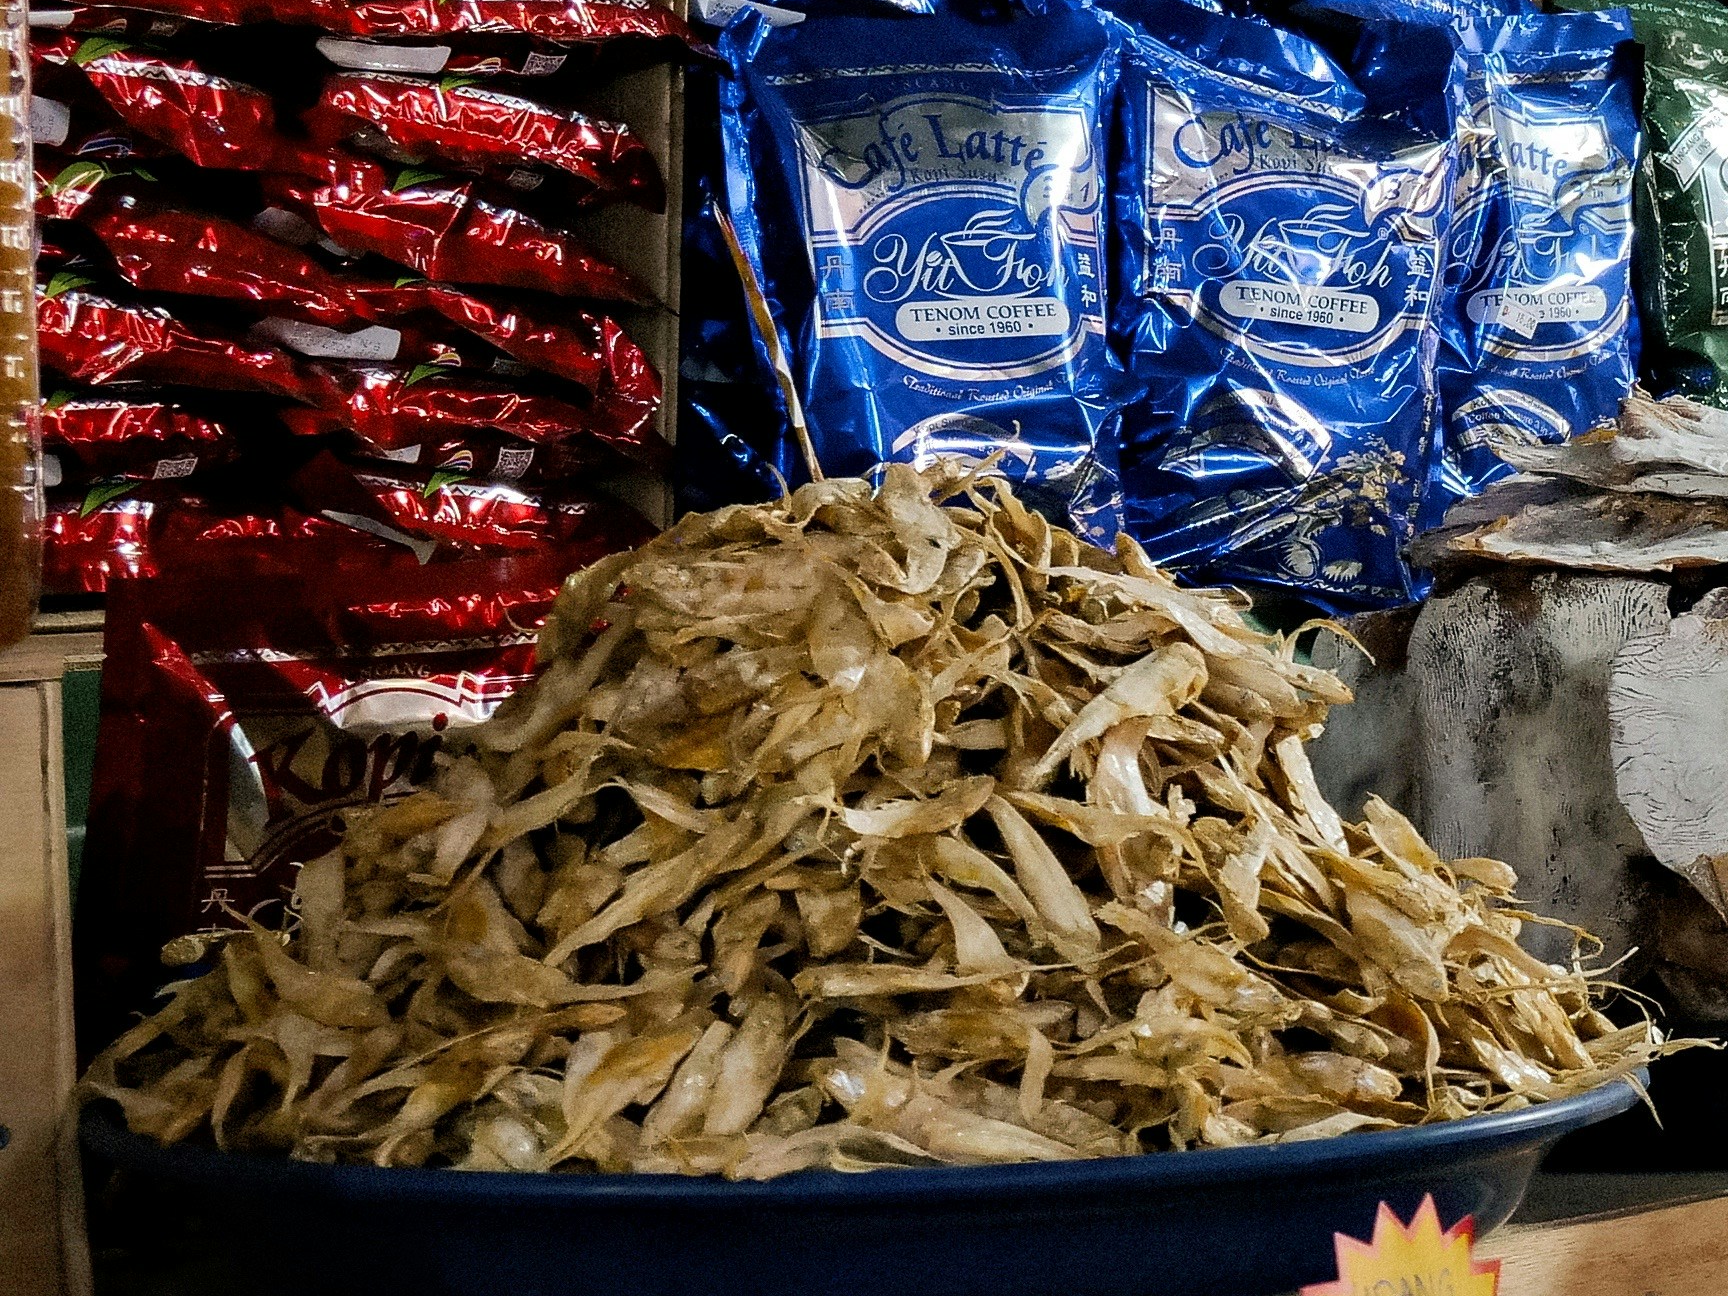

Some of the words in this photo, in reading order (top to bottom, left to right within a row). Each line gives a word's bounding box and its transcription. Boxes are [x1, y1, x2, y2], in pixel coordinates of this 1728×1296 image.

[819, 108, 912, 194] Café
[910, 168, 950, 184] Kopi
[958, 166, 997, 182] Susu
[863, 232, 960, 302] Yit
[1317, 231, 1393, 290] Foh
[820, 255, 852, 311] 丹南
[1407, 248, 1432, 307] 益和
[1235, 285, 1301, 306] TENOM
[1308, 295, 1369, 315] COFFEE
[1547, 290, 1596, 305] COFFEE
[910, 306, 980, 323] TENOM
[987, 303, 1057, 319] COFFEE
[1269, 308, 1303, 321] since
[1306, 311, 1334, 325] 1960
[1549, 306, 1572, 320] 1960
[948, 324, 985, 336] since
[990, 321, 1022, 334] 1960
[903, 375, 963, 400] Traditional
[1013, 380, 1053, 399] Original
[248, 711, 454, 816] Kopi
